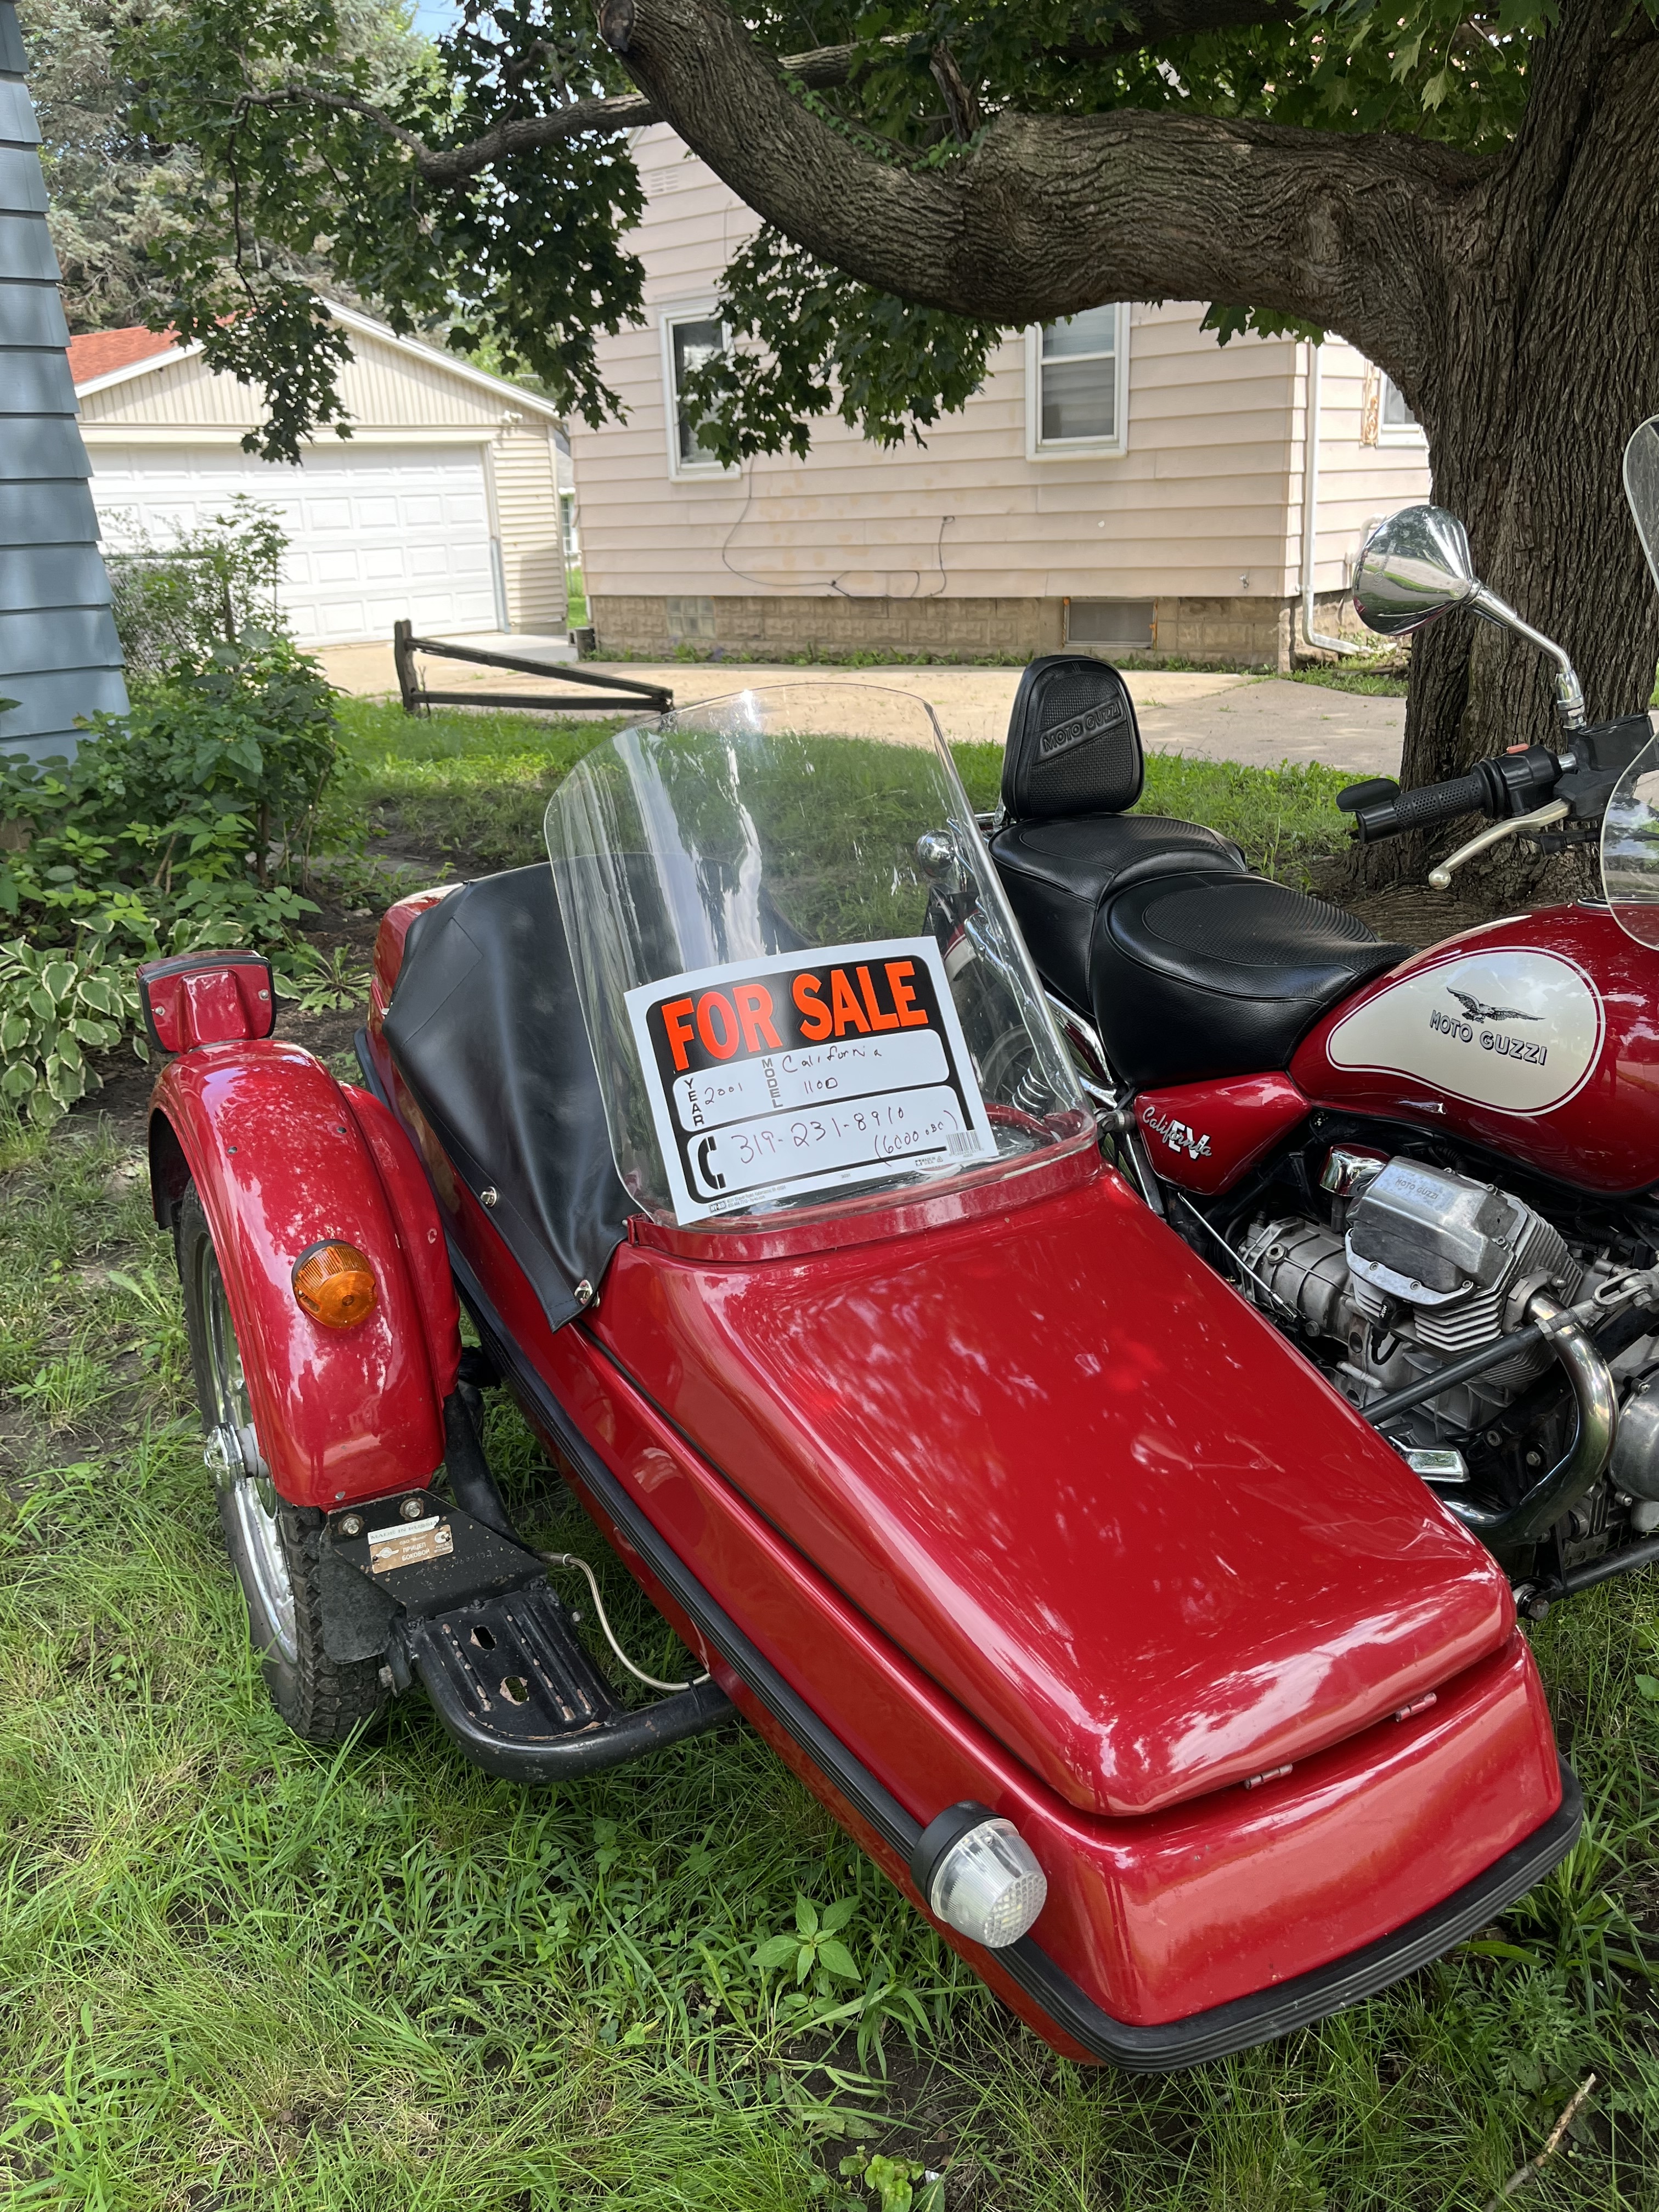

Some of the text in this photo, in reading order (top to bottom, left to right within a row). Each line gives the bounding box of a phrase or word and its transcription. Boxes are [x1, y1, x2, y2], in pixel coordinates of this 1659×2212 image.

[1043, 702, 1121, 752] MOTO GUZZI
[662, 961, 928, 1071] FOR SALE
[1429, 1009, 1547, 1065] MOTO GUZZI
[683, 1078, 704, 1126] YEAR
[704, 1082, 742, 1105] 2001
[761, 1058, 783, 1108] MODEL
[804, 1077, 838, 1094] 1100
[731, 1107, 904, 1164] 319-231-8910
[1142, 1107, 1212, 1156] California
[1169, 1120, 1210, 1159] EV
[1395, 1178, 1439, 1199] MOTO GUZZI
[371, 1530, 396, 1539] MADE
[402, 1548, 430, 1561] БОКОВОЙ
[403, 1542, 426, 1553] ПРИЦЕП
